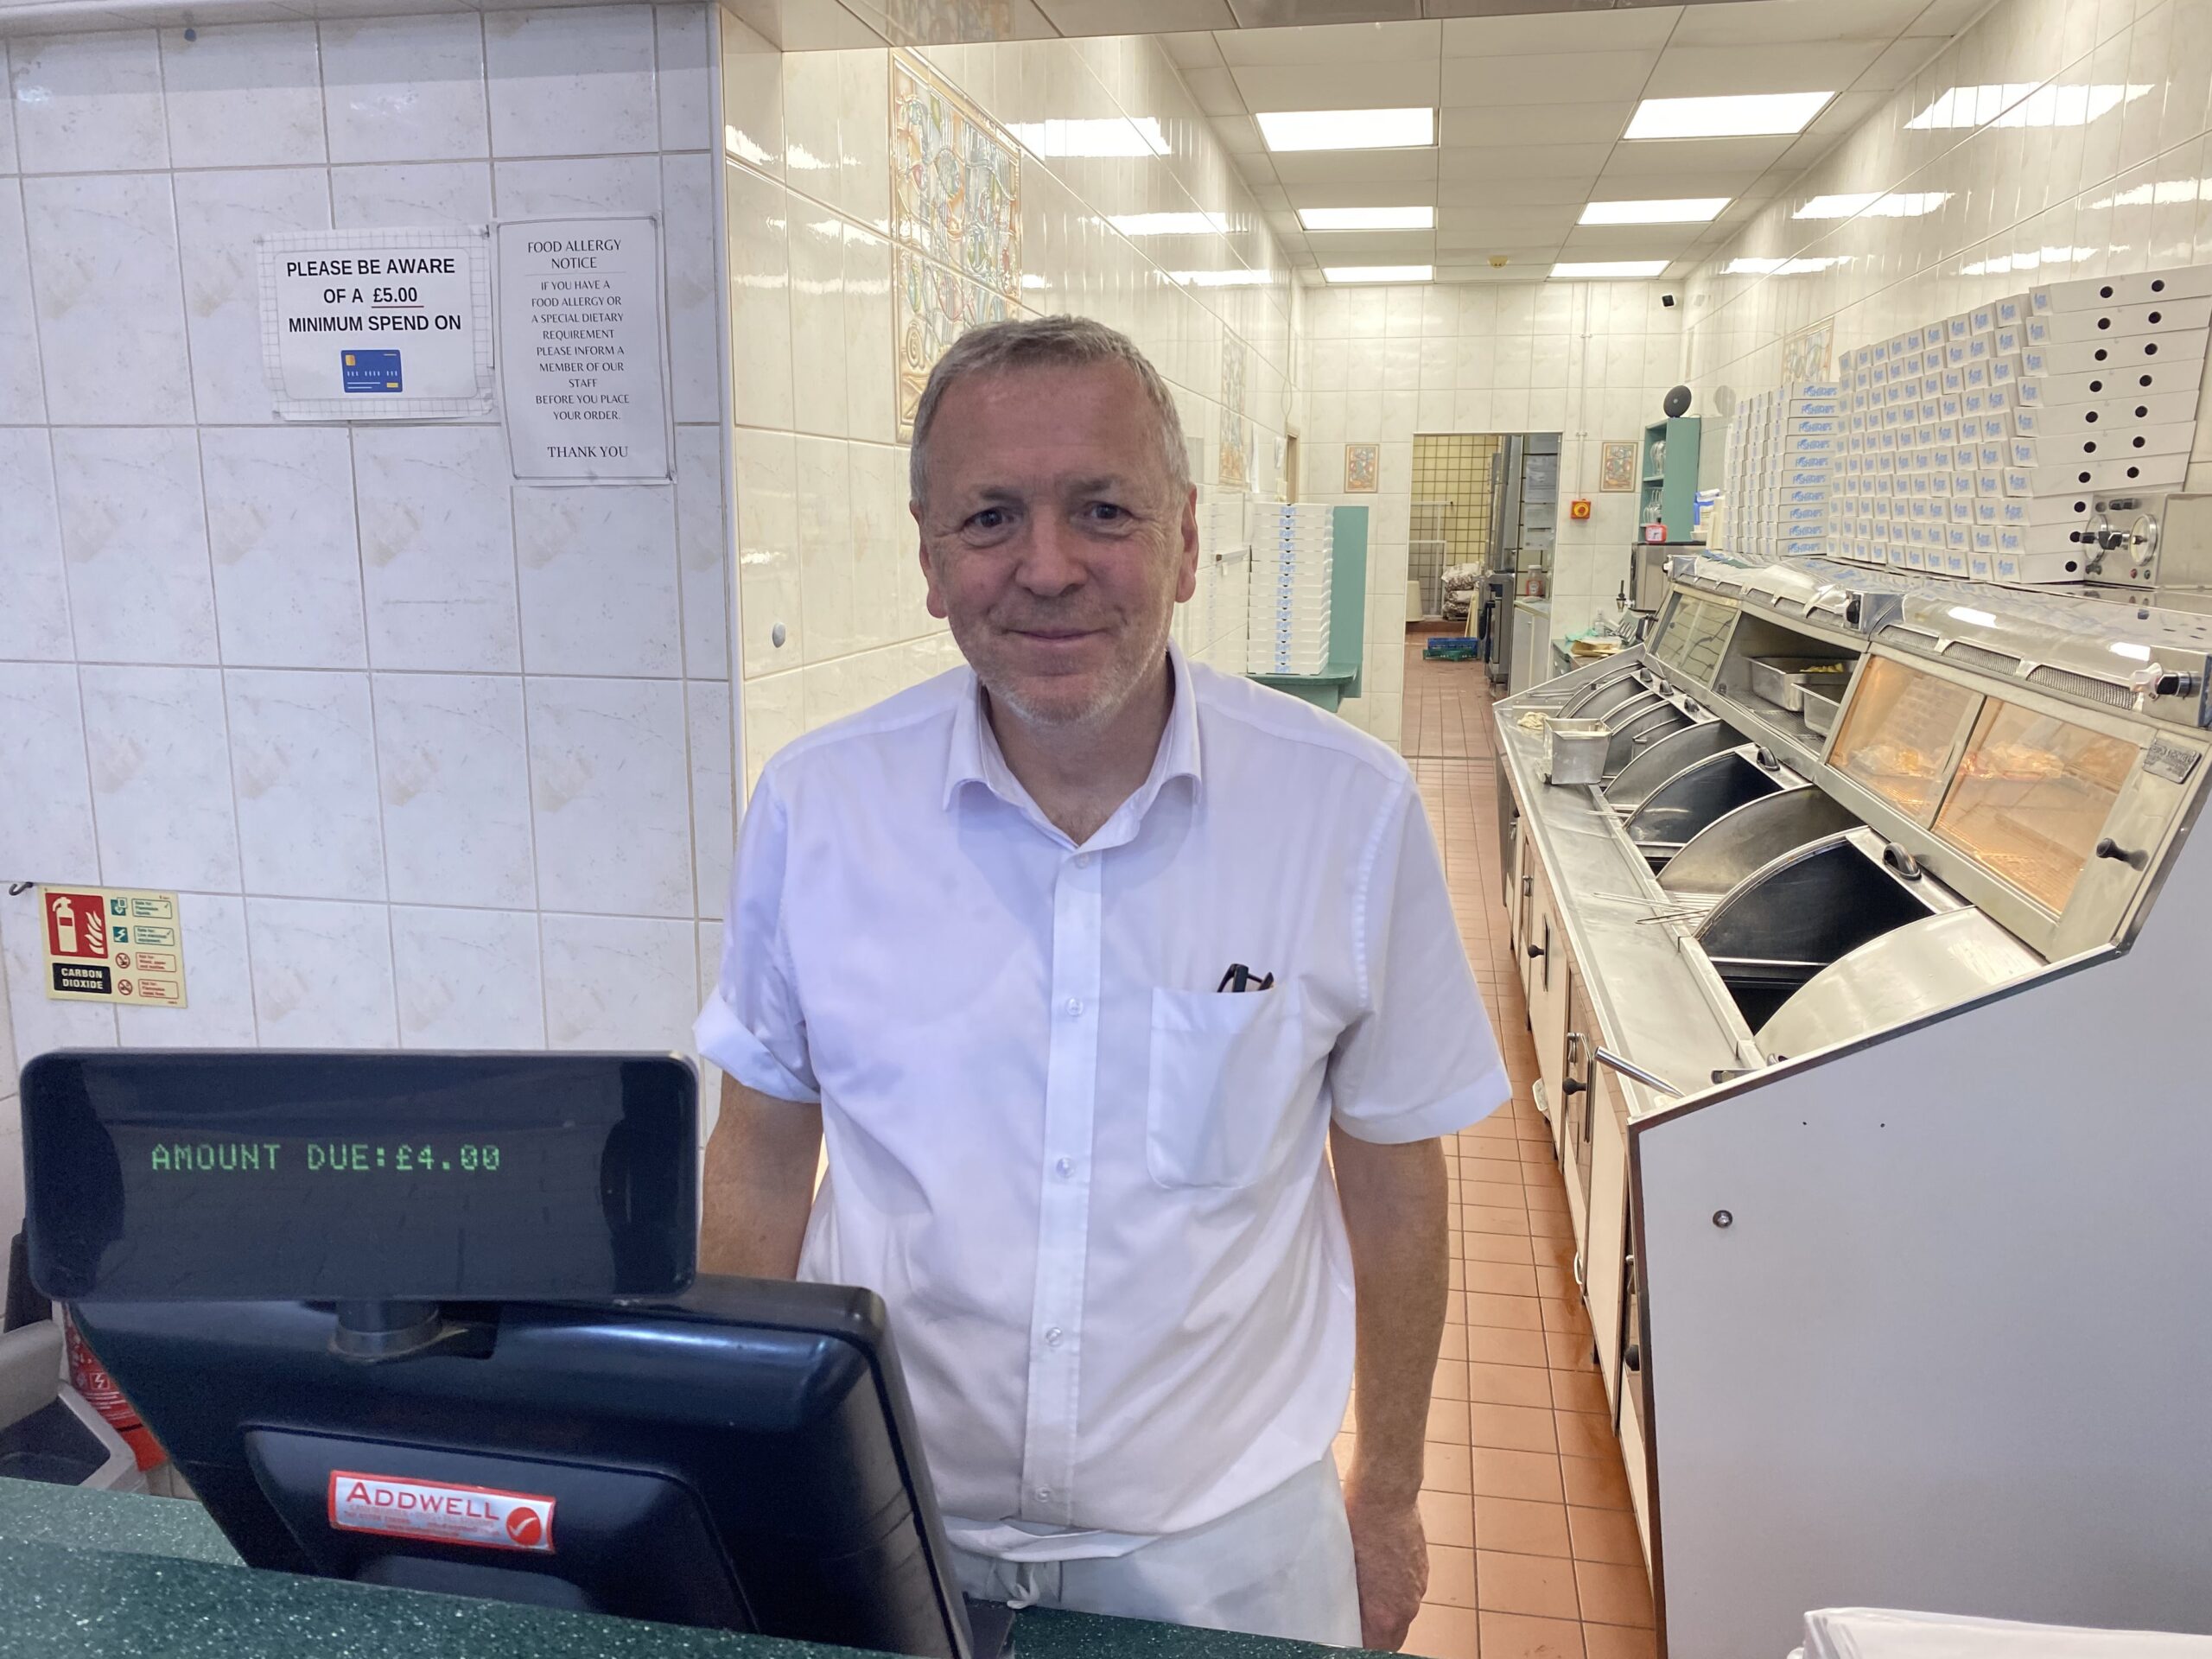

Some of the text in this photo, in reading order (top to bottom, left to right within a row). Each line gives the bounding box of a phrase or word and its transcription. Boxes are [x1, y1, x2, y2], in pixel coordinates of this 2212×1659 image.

[528, 238, 621, 253] FOOD ALLERGY
[287, 258, 455, 277] PLEASE BE AWARE
[551, 257, 597, 269] NOTICE
[541, 280, 611, 291] IF YOU HAVE A
[323, 287, 417, 304] OF A £5.00
[531, 296, 622, 308] FOOD ALLERGY OR
[531, 312, 624, 323] A SPECIAL DIETARY
[289, 315, 461, 333] MINIMUM SPEND ON
[543, 329, 615, 341] REQUIREMENT
[537, 346, 625, 356] PLEASE INFORM A
[539, 362, 624, 372] MEMBER OF OUR
[569, 378, 598, 388] STAFF
[536, 394, 630, 404] BEFORE YOU PLACE
[553, 410, 621, 421] YOUR ORDER.
[547, 446, 628, 458] THANK YOU
[60, 968, 103, 979] CARBON
[62, 978, 104, 989] DIOXIDE
[151, 1143, 282, 1171] AMOUNT
[346, 1481, 500, 1521] ADDWELL
